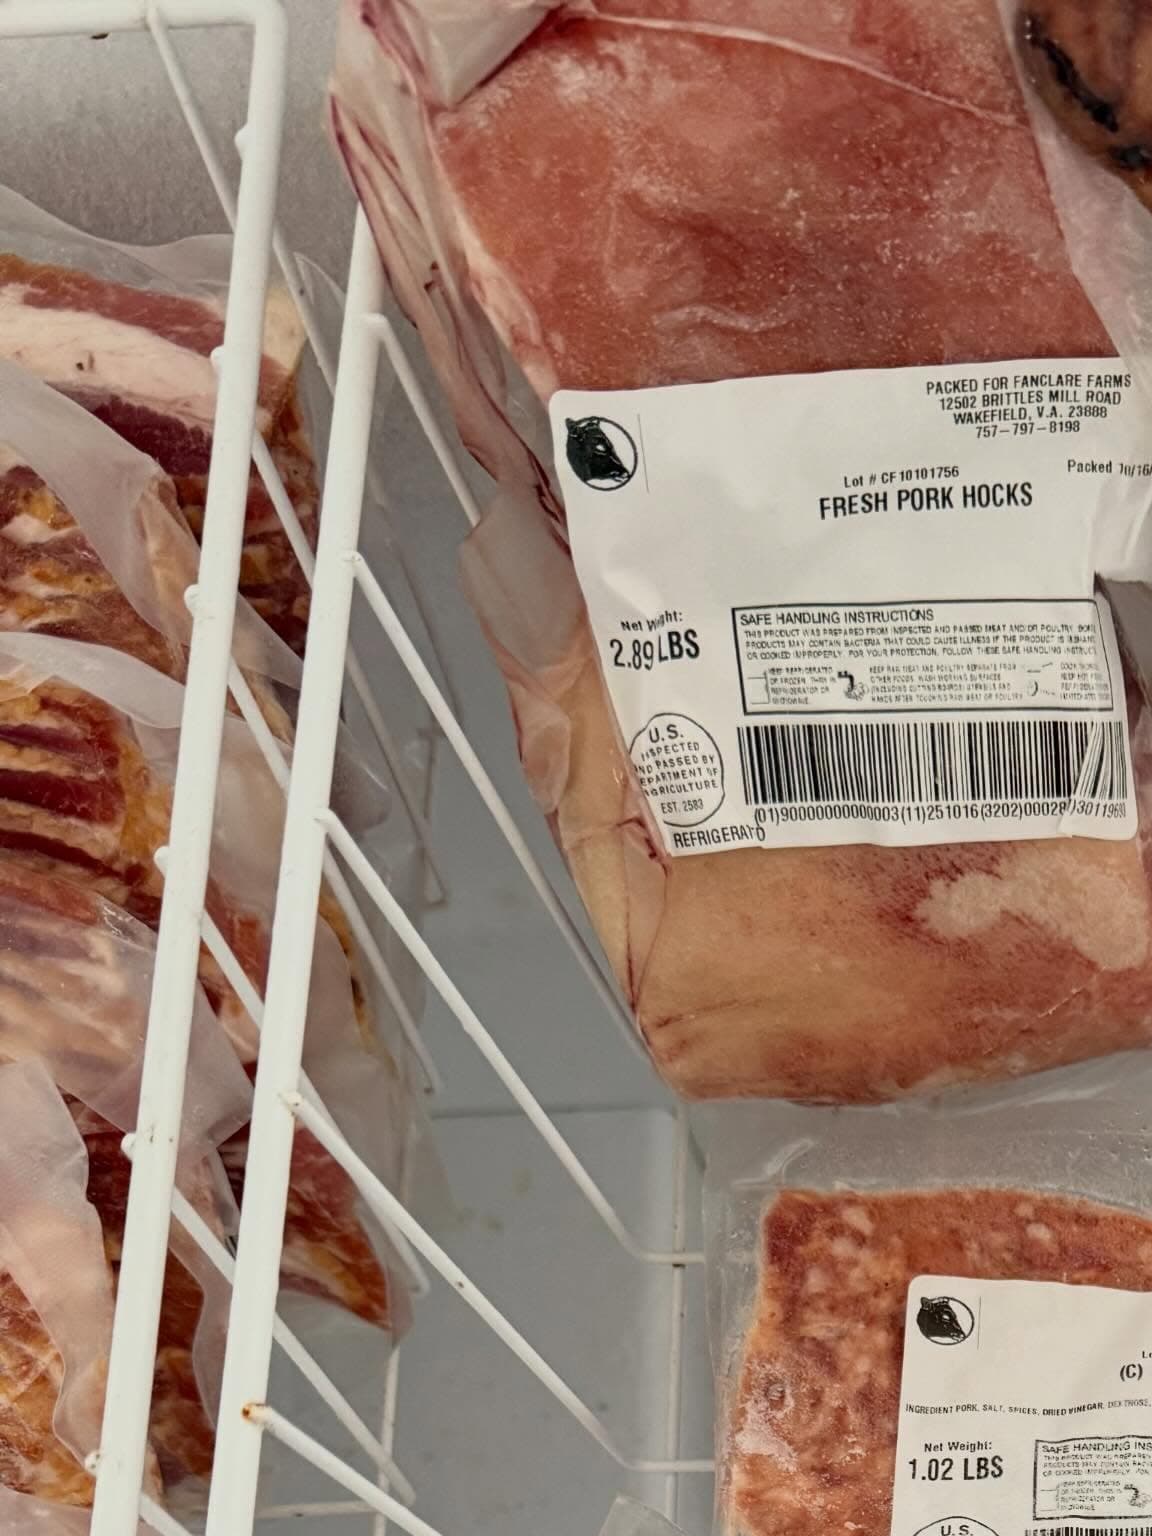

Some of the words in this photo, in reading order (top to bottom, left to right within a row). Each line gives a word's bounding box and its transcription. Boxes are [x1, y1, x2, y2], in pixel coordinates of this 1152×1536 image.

[926, 378, 977, 395] PACKED
[984, 377, 1008, 391] FOR
[1014, 374, 1082, 389] FANCLARE
[1087, 374, 1131, 388] FARMS
[940, 397, 976, 410] 12502
[982, 391, 1043, 407] BRITTLES
[1049, 390, 1078, 404] MILL
[1086, 391, 1121, 405] ROAD
[954, 408, 1031, 424] WAKEFIELD,
[1037, 406, 1062, 419] V.A.
[1068, 406, 1107, 418] 23888
[1067, 459, 1112, 474] Packed
[844, 475, 864, 488] Lot
[881, 466, 959, 484] CF10101756
[819, 490, 888, 520] FRESH
[897, 488, 954, 512] PORK
[962, 482, 1033, 509] HOCKS
[740, 614, 772, 625] SAFE
[776, 612, 841, 624] HANDLING
[844, 609, 934, 623] INSTRUCTIONS
[621, 621, 643, 632] Net
[610, 639, 654, 670] 2.89
[659, 629, 699, 662] LBS
[650, 724, 683, 742] U.S.
[656, 756, 699, 769] PASSED
[702, 755, 715, 764] BY
[640, 768, 702, 786] EPARTMENT
[1119, 1364, 1143, 1382] (C)
[906, 1403, 953, 1414] INGREDIENT
[924, 1442, 943, 1453] Net
[947, 1440, 992, 1452] Weight:
[1042, 1444, 1070, 1454] SAFE
[909, 1459, 954, 1481] 1.02
[964, 1456, 1003, 1480] LBS
[941, 1525, 974, 1536] U.S.
